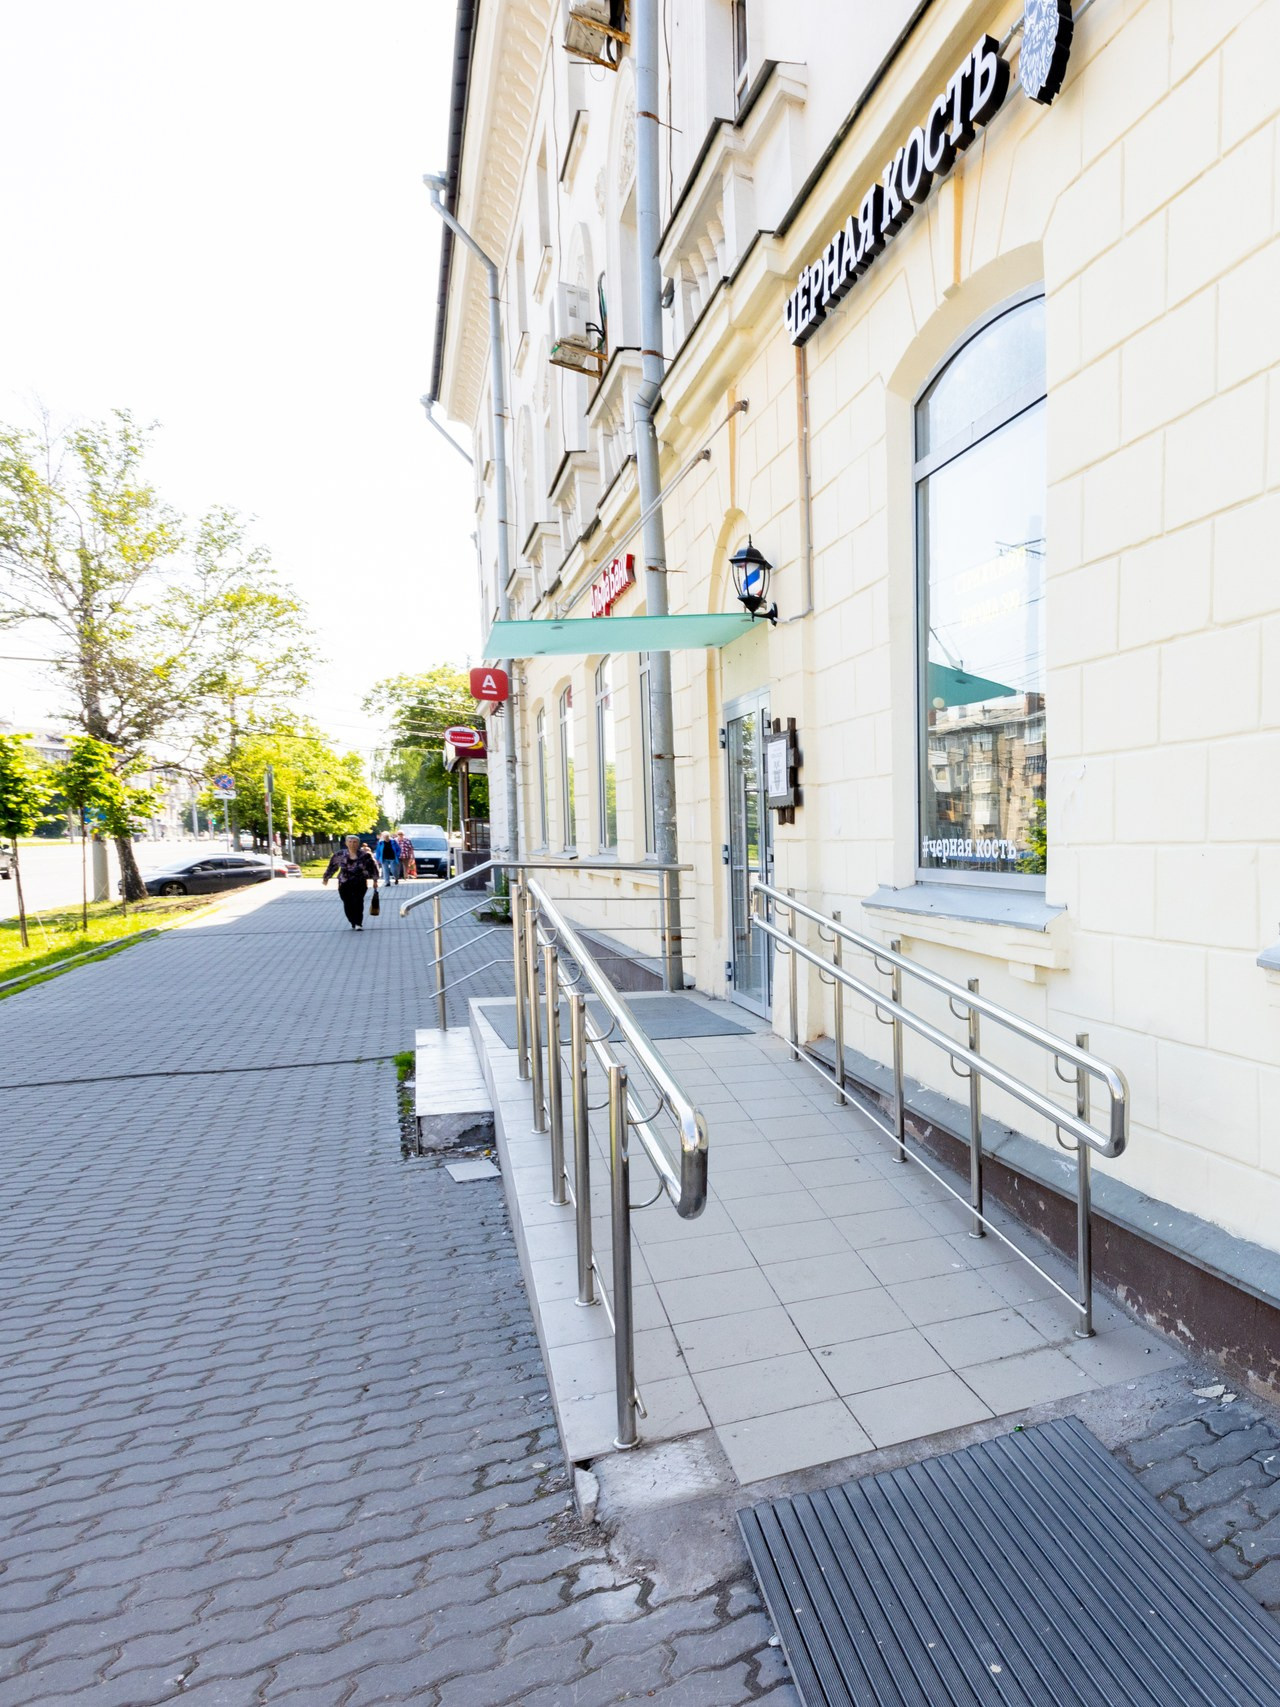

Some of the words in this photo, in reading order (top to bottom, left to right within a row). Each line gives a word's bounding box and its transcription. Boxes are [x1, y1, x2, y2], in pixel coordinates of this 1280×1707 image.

[784, 183, 880, 345] ЧЁРНАЯ
[880, 33, 1004, 236] КОСТЬ
[922, 835, 973, 863] #черная
[975, 838, 1017, 860] кость
